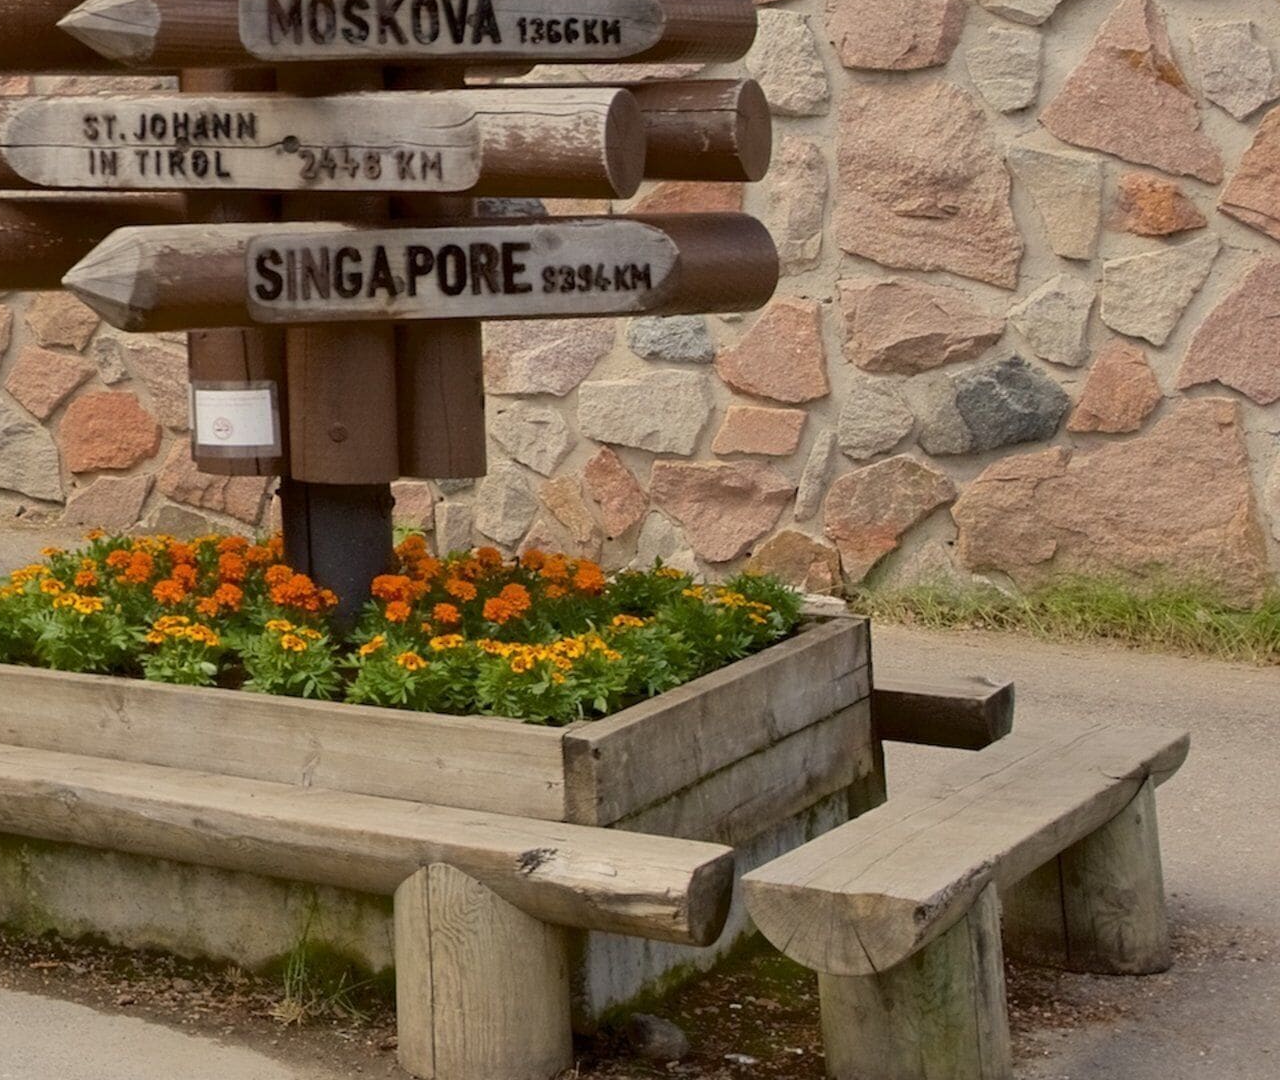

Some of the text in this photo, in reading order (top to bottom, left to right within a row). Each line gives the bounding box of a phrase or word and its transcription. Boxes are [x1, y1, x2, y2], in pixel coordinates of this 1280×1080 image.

[132, 110, 259, 142] JOHANN
[89, 150, 231, 178] IN TIROL
[298, 150, 444, 181] 2448 KM
[254, 241, 534, 302] SINGAPORE
